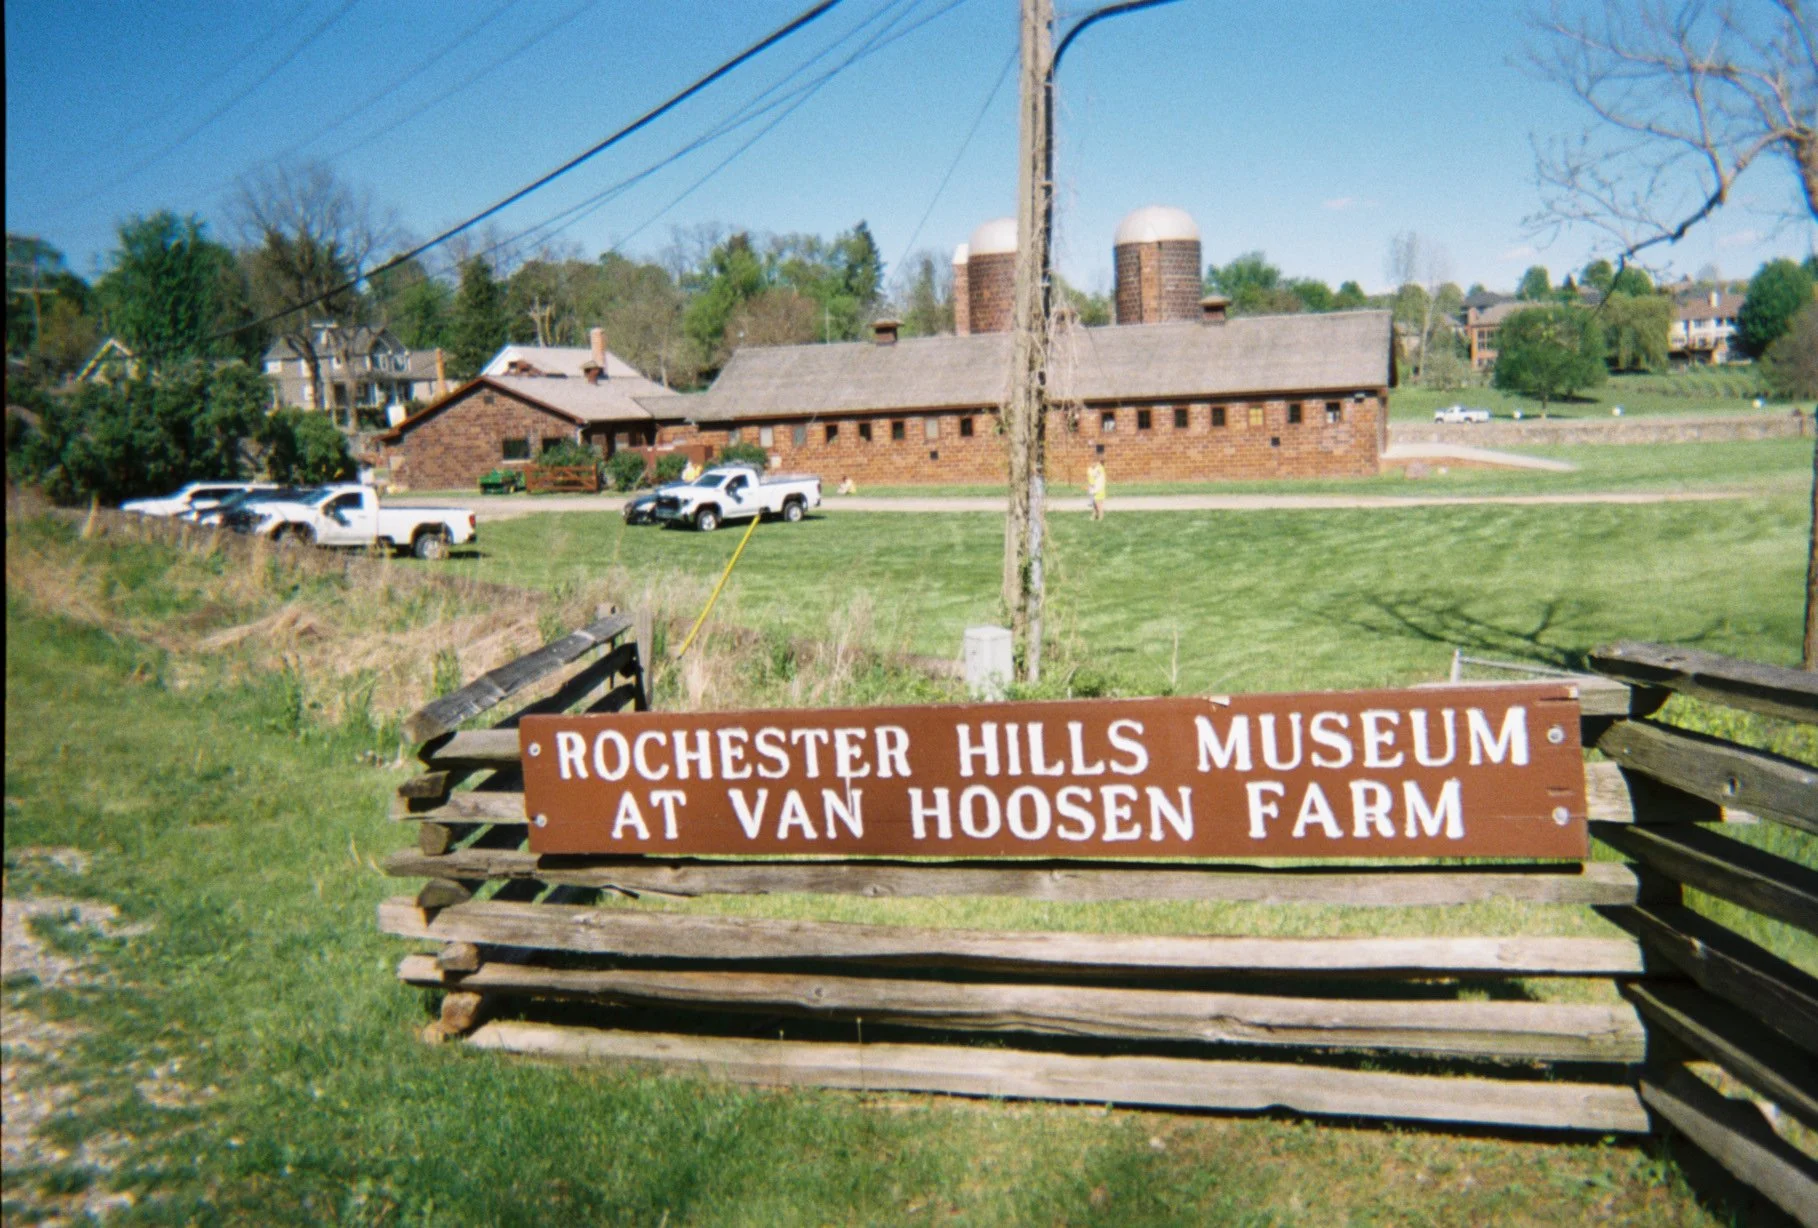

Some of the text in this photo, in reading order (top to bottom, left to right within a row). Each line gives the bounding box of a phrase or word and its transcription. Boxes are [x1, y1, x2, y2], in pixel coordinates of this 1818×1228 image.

[555, 704, 1530, 783] ROCHESTER HILLS MUSEUM
[610, 776, 1466, 843] AT VAN HOOSEN FARM
